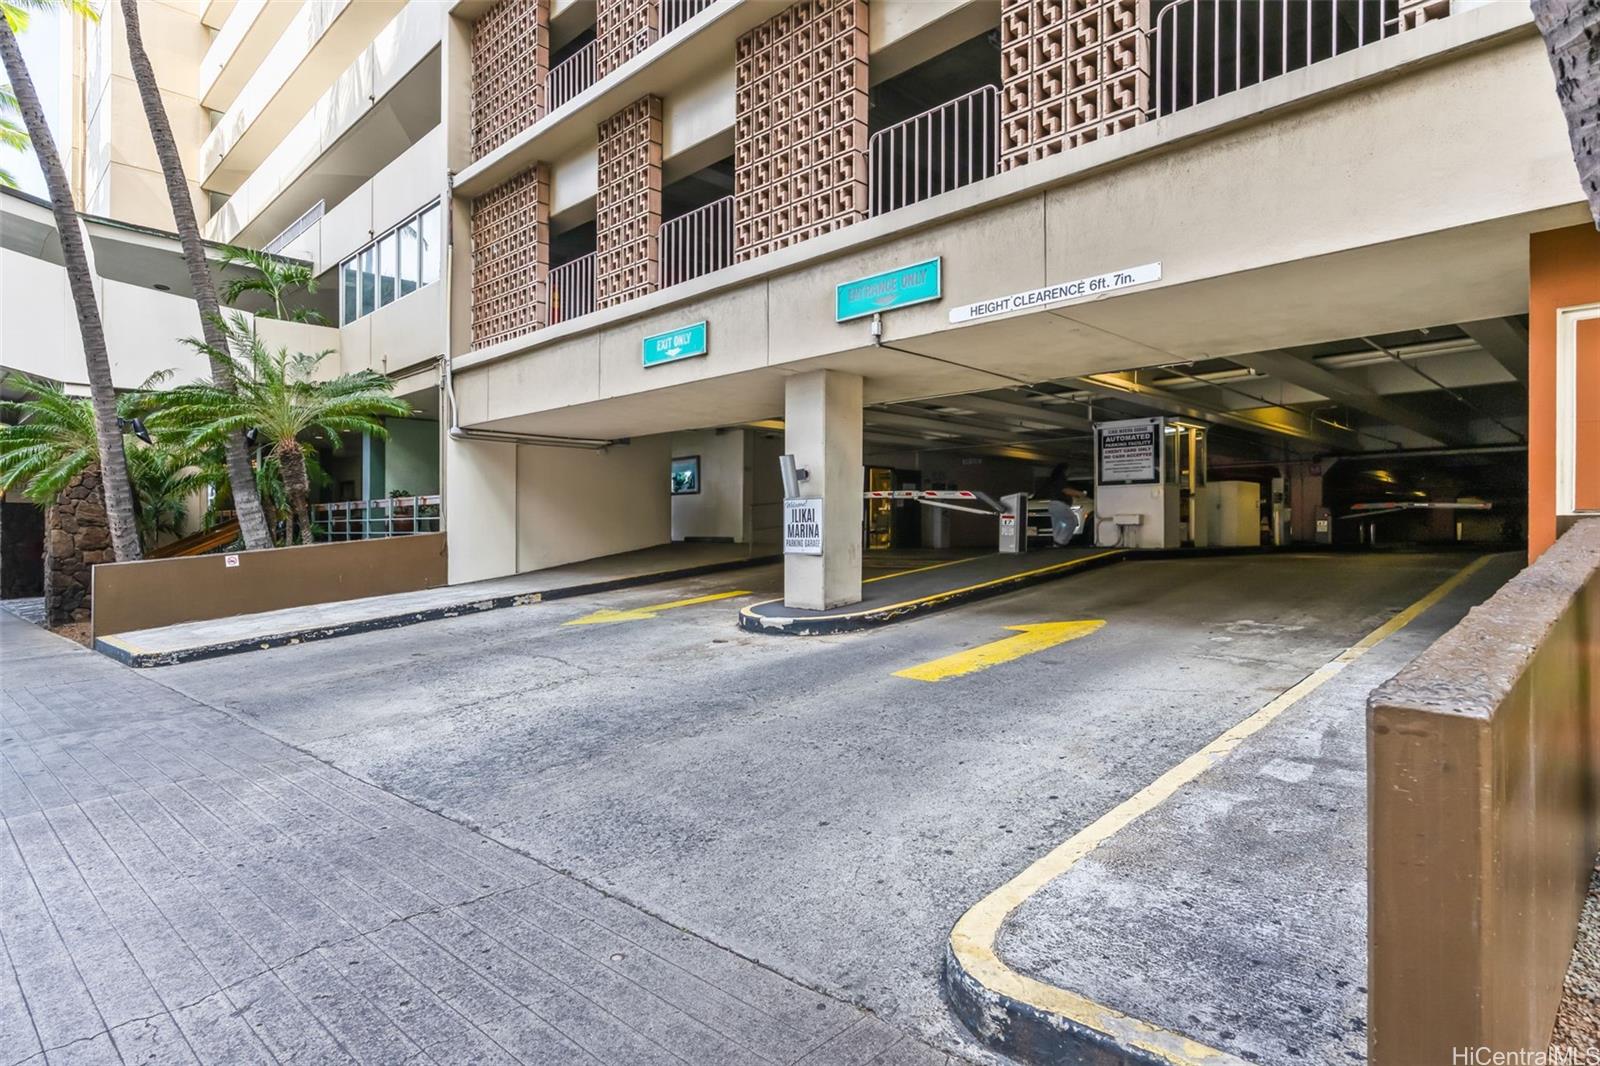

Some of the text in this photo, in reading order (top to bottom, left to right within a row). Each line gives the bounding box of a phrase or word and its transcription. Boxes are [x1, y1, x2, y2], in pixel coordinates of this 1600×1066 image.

[902, 269, 928, 288] ONLY
[970, 272, 1136, 317] HEIGHT CLEARENCE 6ft. 7in.
[656, 331, 692, 352] EXIT ONLY
[1105, 433, 1151, 442] AUTOMATED
[791, 508, 815, 523] ILIKAI
[787, 523, 820, 538] MARINA
[786, 538, 820, 547] PARKING GARAGE
